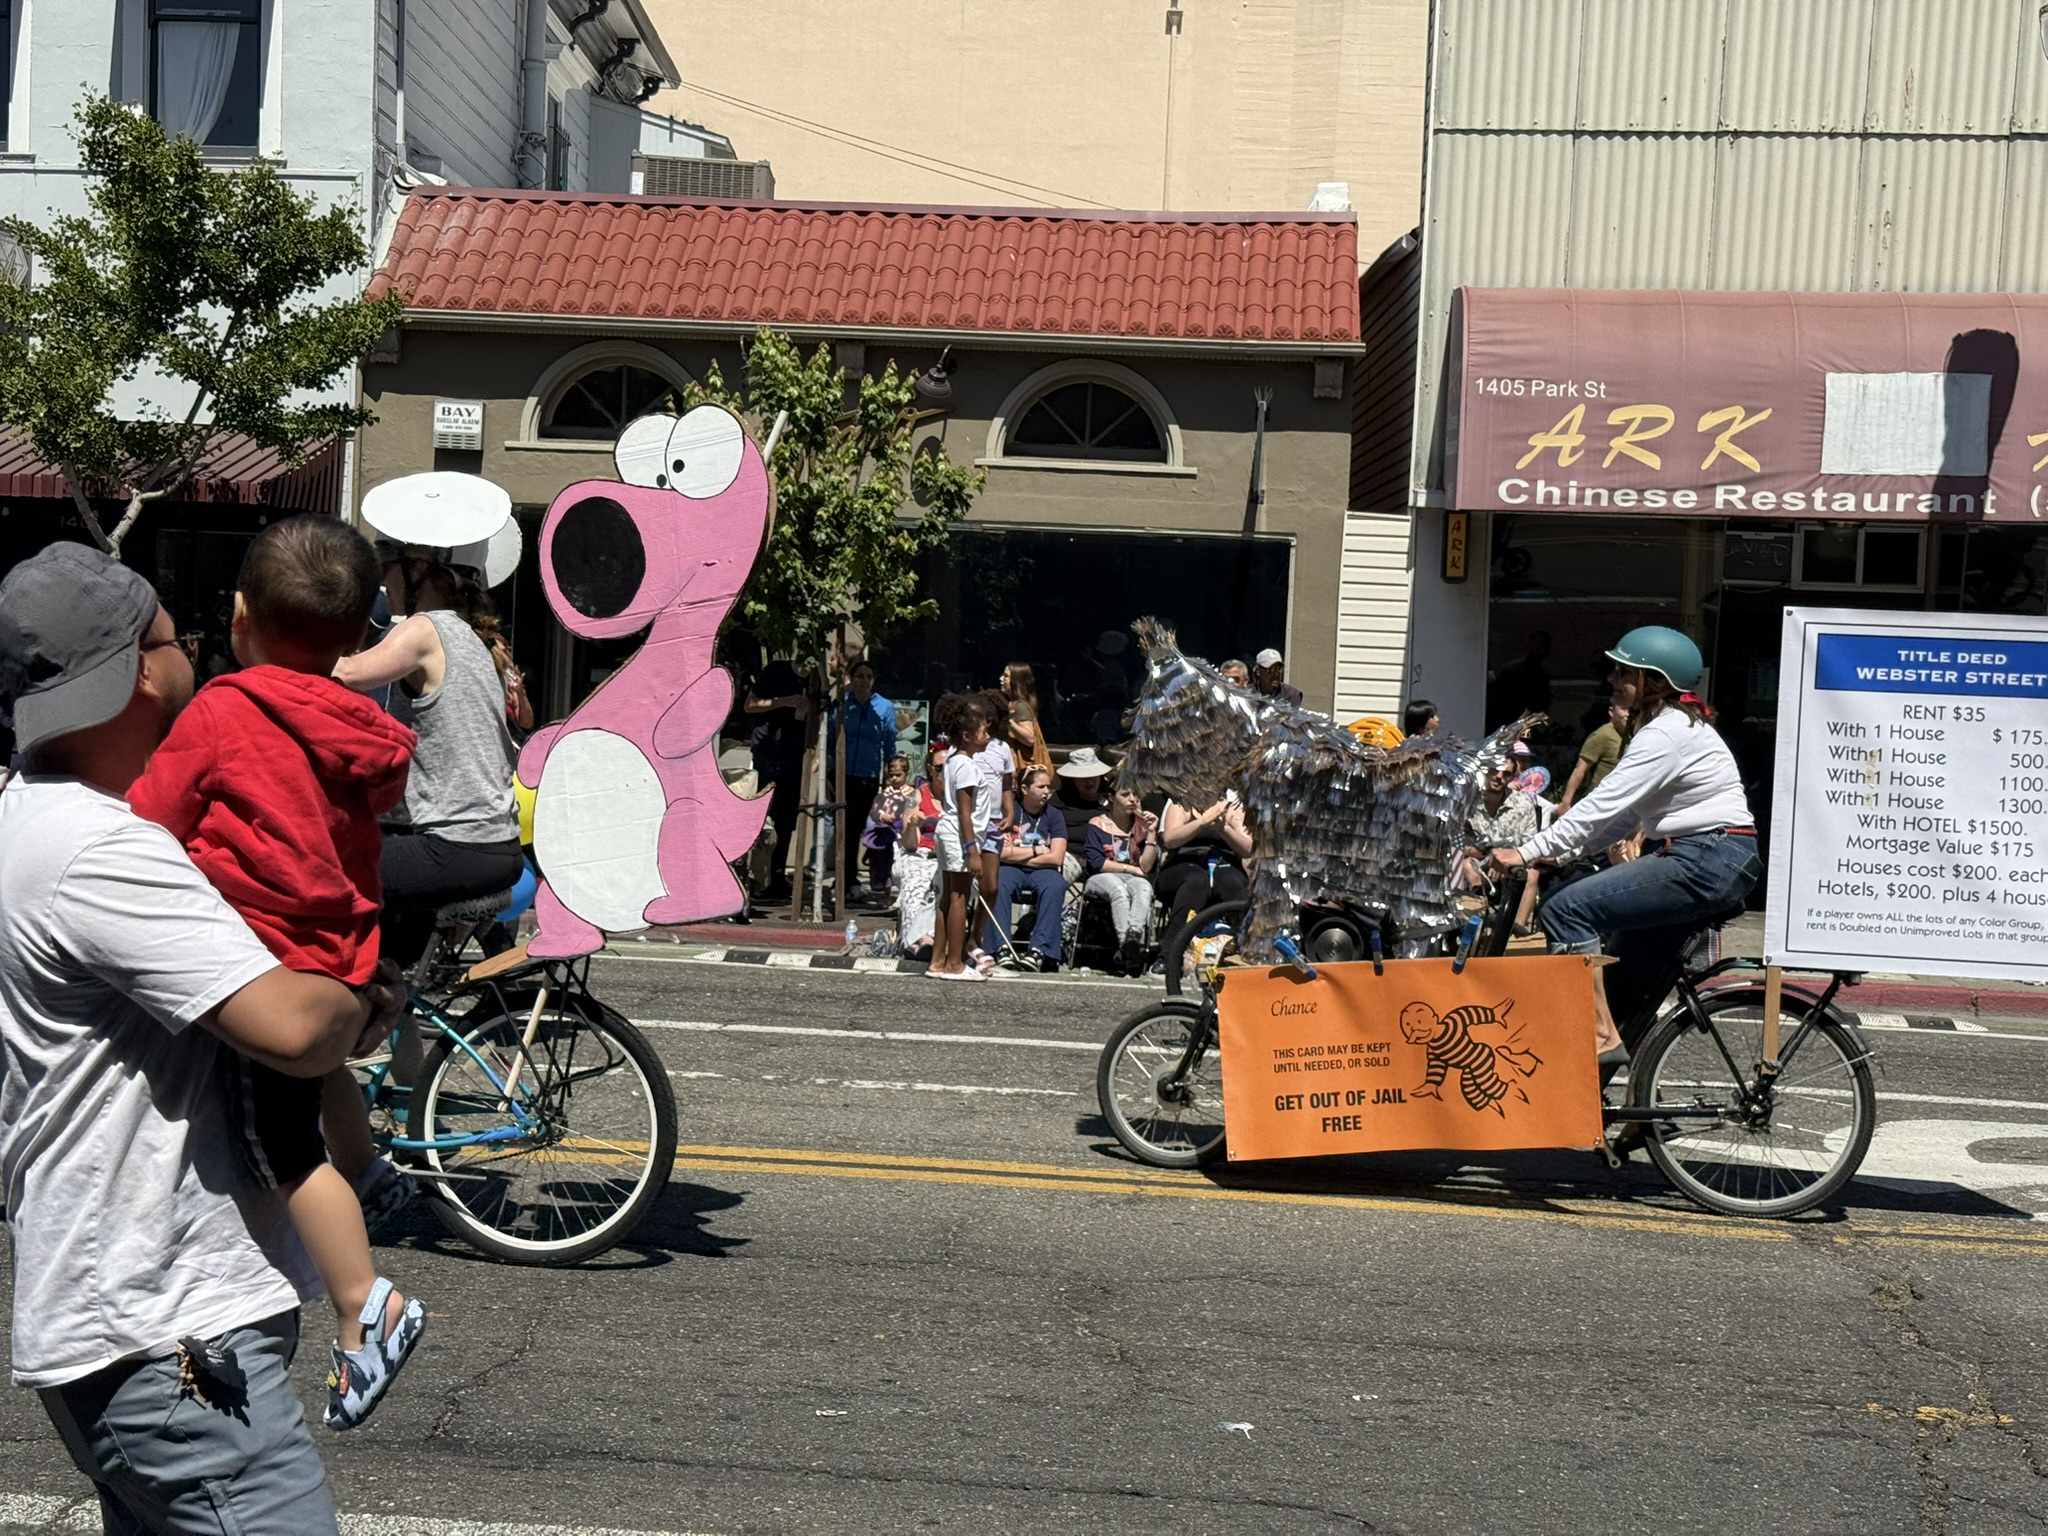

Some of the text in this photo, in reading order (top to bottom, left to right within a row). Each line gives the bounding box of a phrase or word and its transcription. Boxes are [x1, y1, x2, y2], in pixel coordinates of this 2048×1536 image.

[1475, 378, 1606, 398] 1405 Park St
[442, 406, 476, 417] BAY
[1516, 403, 1772, 472] ARK
[1498, 478, 1996, 515] Chinese Restaurant
[1898, 650, 2007, 665] TITLE DEED
[1857, 667, 2047, 687] WEBSTER STREET
[1903, 705, 1985, 722] RENT $35
[1827, 722, 1866, 738] With
[1874, 724, 1880, 738] 1
[1890, 724, 1944, 741] House
[1829, 745, 1867, 762] With
[1892, 748, 1947, 765] House
[1827, 768, 1865, 784] With
[1890, 771, 1945, 788] House
[1826, 790, 1865, 806] With
[1888, 793, 1944, 810] House
[1857, 813, 2027, 836] With HOTEL $1500.
[1846, 835, 2034, 858] Mortgage Value $175
[1838, 858, 2048, 883] Houses cost $200. each
[1818, 880, 1879, 900] Hotels,
[1887, 882, 1935, 900] $200.
[1943, 887, 1979, 903] plus
[1986, 889, 1996, 902] 4
[1808, 908, 1815, 917] If
[1824, 909, 1854, 920] player
[1857, 912, 1883, 921] owns
[1885, 912, 1903, 922] ALL
[1907, 913, 1922, 922] the
[1925, 914, 1943, 924] lots
[1946, 916, 1957, 925] of
[1959, 917, 1976, 927] any
[1979, 917, 2006, 928] Color
[2009, 919, 2044, 931] Group,
[1807, 922, 1826, 931] rent
[1829, 922, 1836, 931] is
[1840, 923, 1881, 933] Doubled
[1884, 926, 1897, 934] on
[1900, 926, 1959, 938] Unimproved
[1963, 929, 1983, 939] Lots
[1986, 931, 1995, 940] in
[1998, 931, 2018, 941] that
[1271, 996, 1317, 1017] Chance
[1273, 1042, 1391, 1059] THIS CARD MAY BE KEPT
[1273, 1056, 1390, 1074] UNTIL NEEDED, OR SOLD
[1275, 1087, 1407, 1111] GET OUT OF JAIL
[1322, 1115, 1362, 1133] FREE
